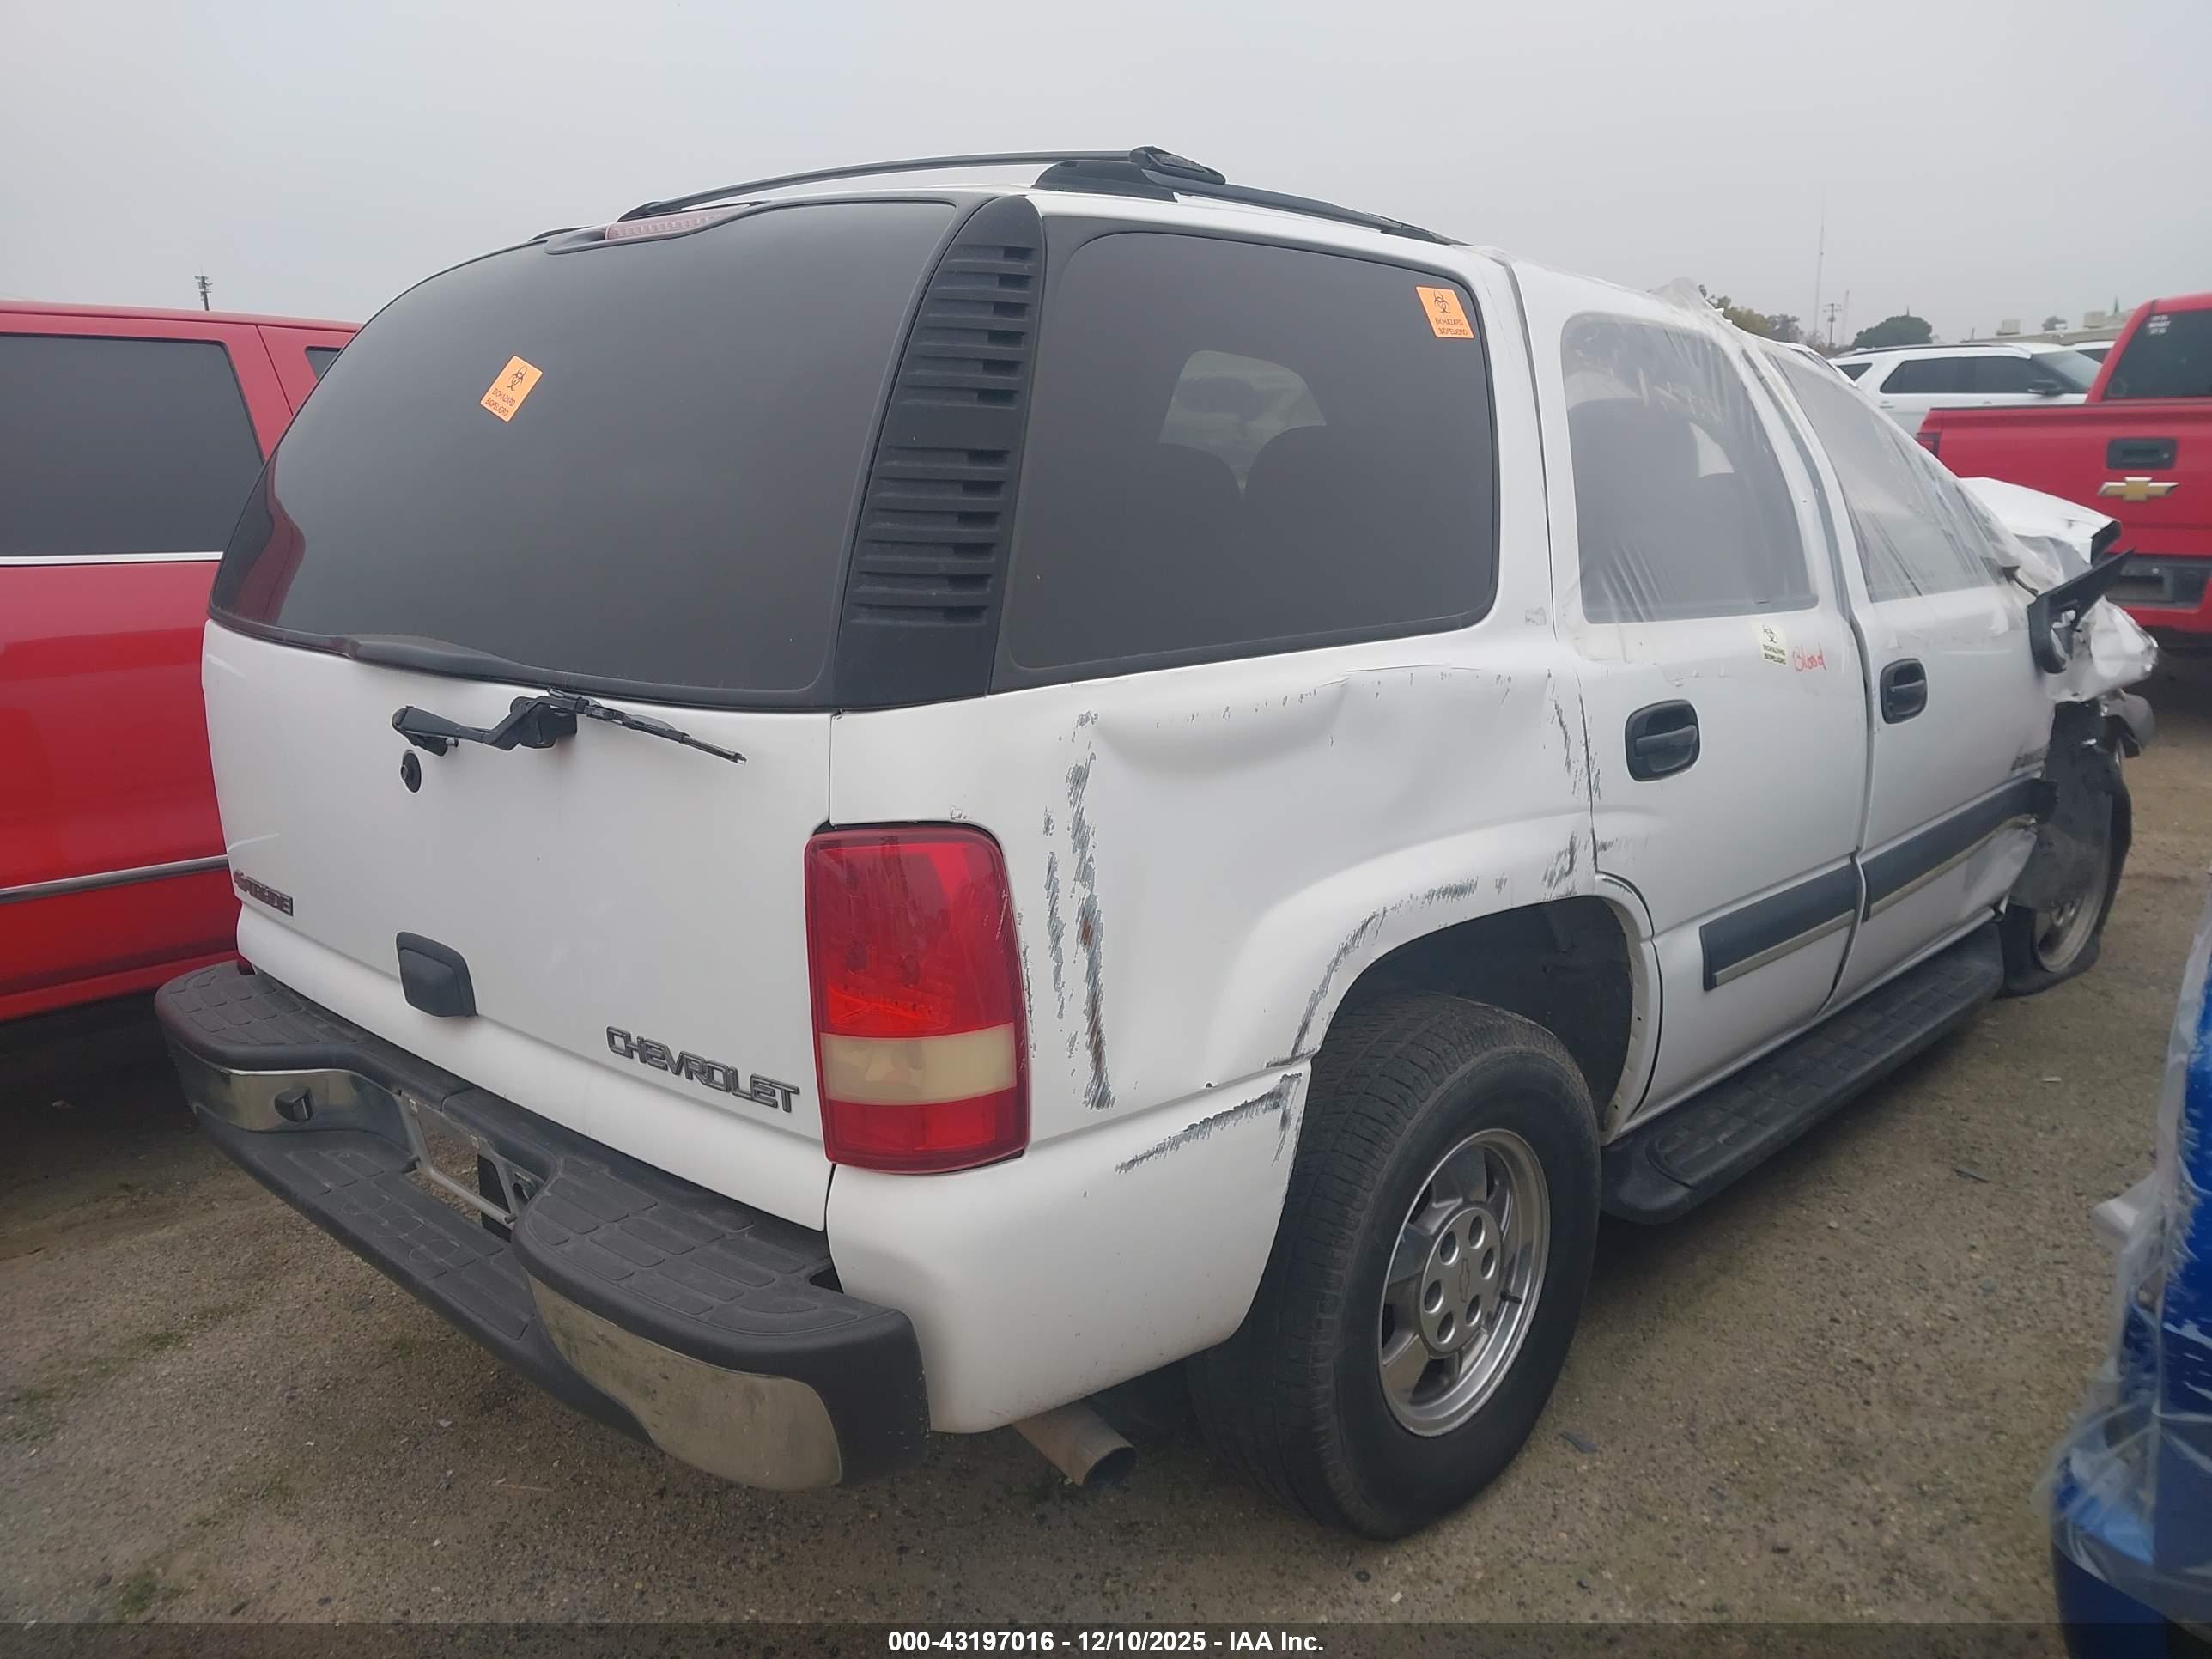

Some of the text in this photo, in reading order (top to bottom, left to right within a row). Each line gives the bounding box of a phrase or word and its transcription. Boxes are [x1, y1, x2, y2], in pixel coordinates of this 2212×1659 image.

[1434, 318, 1464, 326] BIOHAZARD
[1437, 327, 1468, 336] BIOPELIGRO
[484, 397, 509, 417] BIOPELIGRO
[492, 387, 516, 407] BIOHAZARD
[606, 1025, 800, 1114] CHEVROLET
